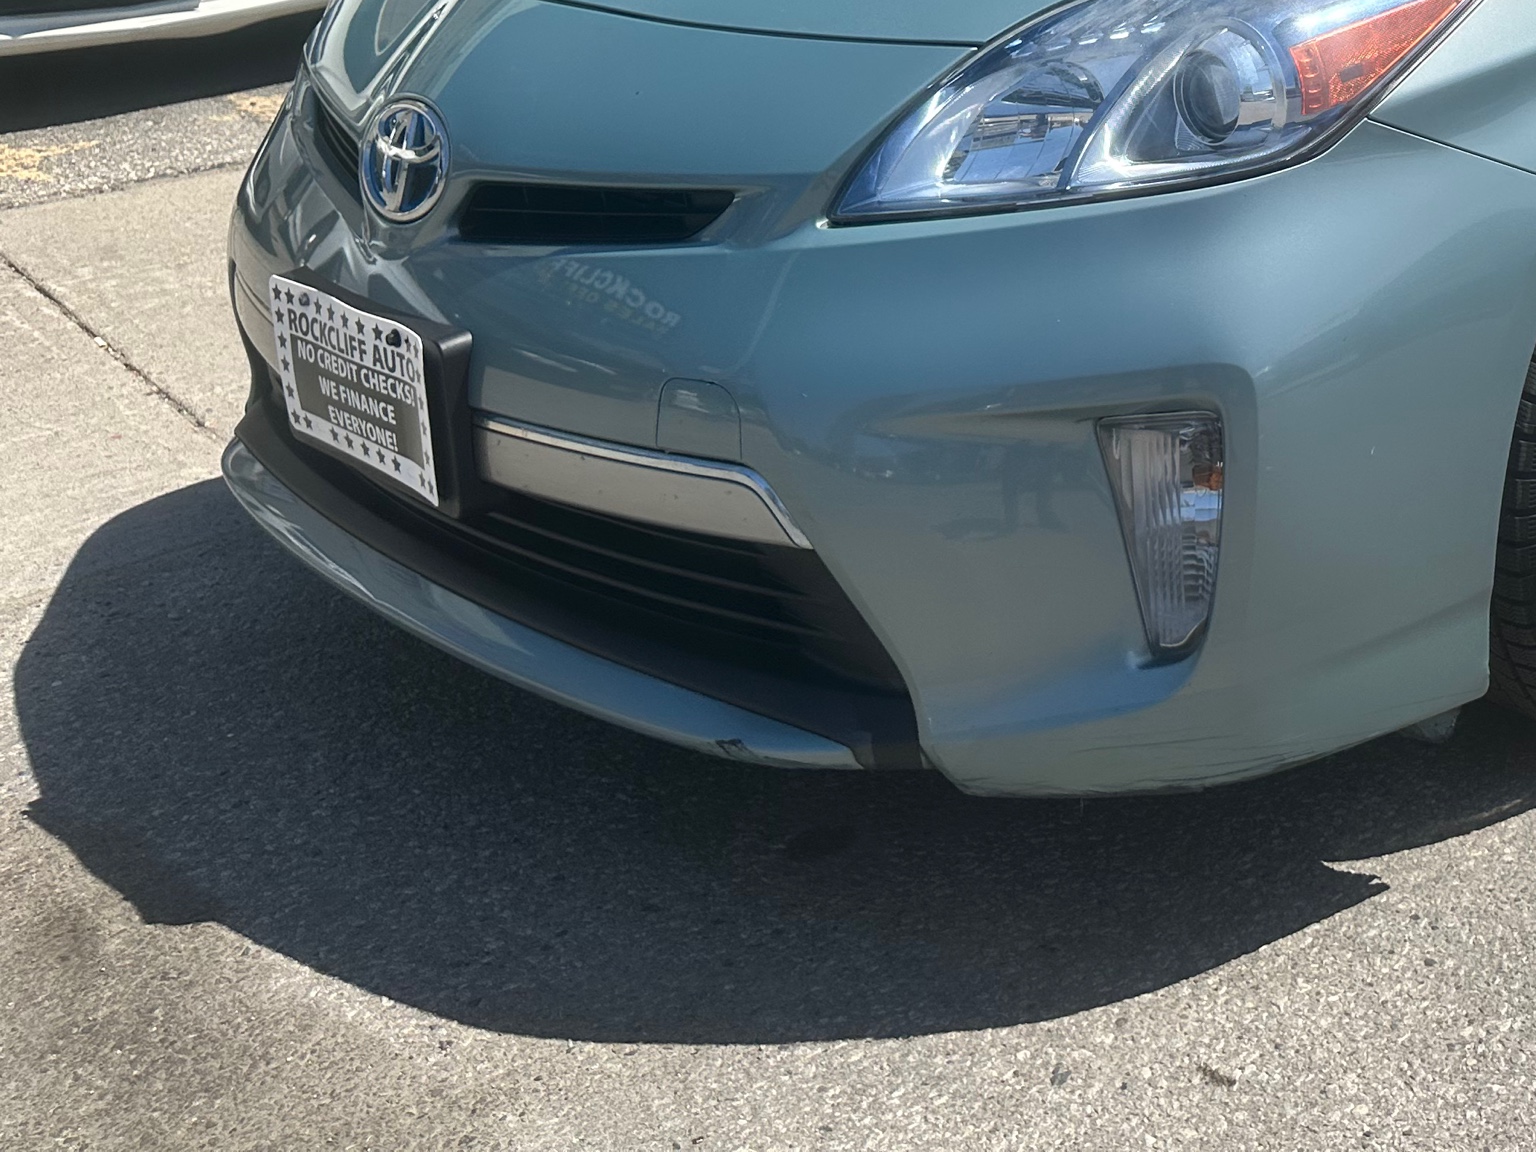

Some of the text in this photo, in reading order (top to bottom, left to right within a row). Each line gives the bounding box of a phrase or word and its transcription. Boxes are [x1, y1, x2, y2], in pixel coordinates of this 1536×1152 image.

[287, 308, 416, 384] ROCKCLIFF AUTO
[297, 339, 416, 407] NO CREDIT CHECKS!
[318, 376, 397, 425] WE FINANCE
[328, 405, 398, 452] EVERYONE!
